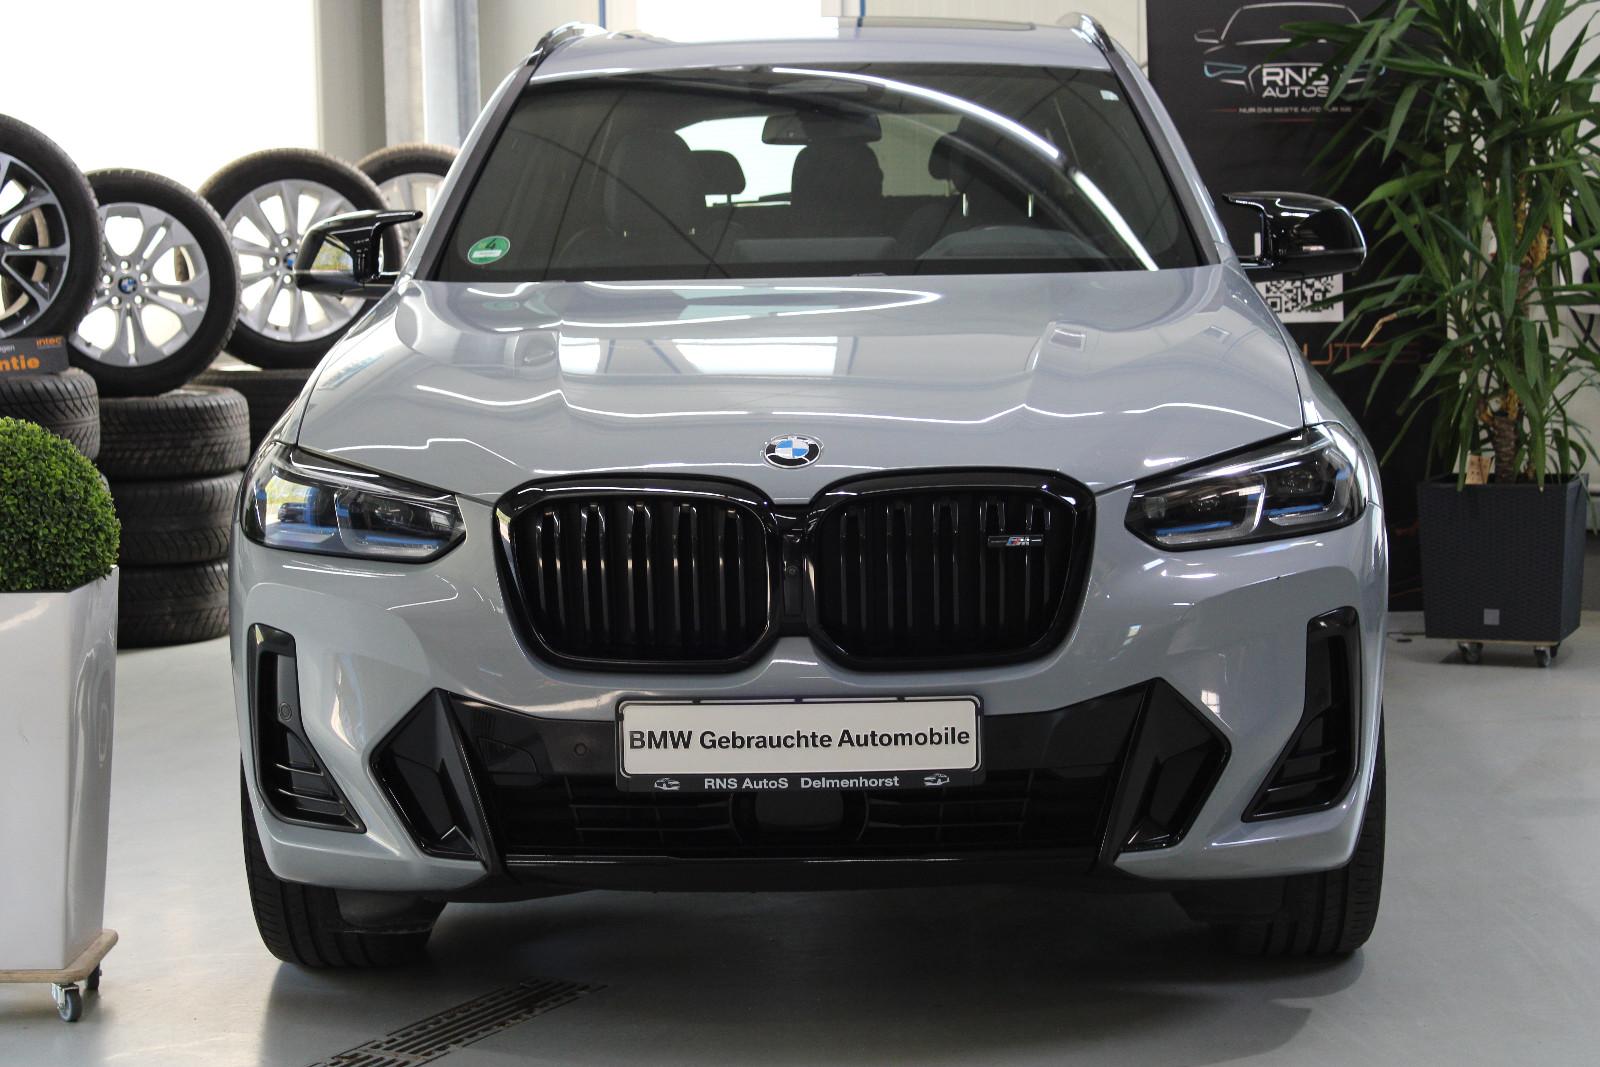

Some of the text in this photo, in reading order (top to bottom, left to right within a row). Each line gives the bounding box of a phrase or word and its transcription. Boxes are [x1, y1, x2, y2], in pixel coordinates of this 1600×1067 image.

[1262, 67, 1329, 86] RNS
[1262, 85, 1330, 98] AUTOS
[629, 726, 970, 750] BMW Gebrauchte Automobile
[704, 775, 900, 790] RNS AutoS Delmenhorst
